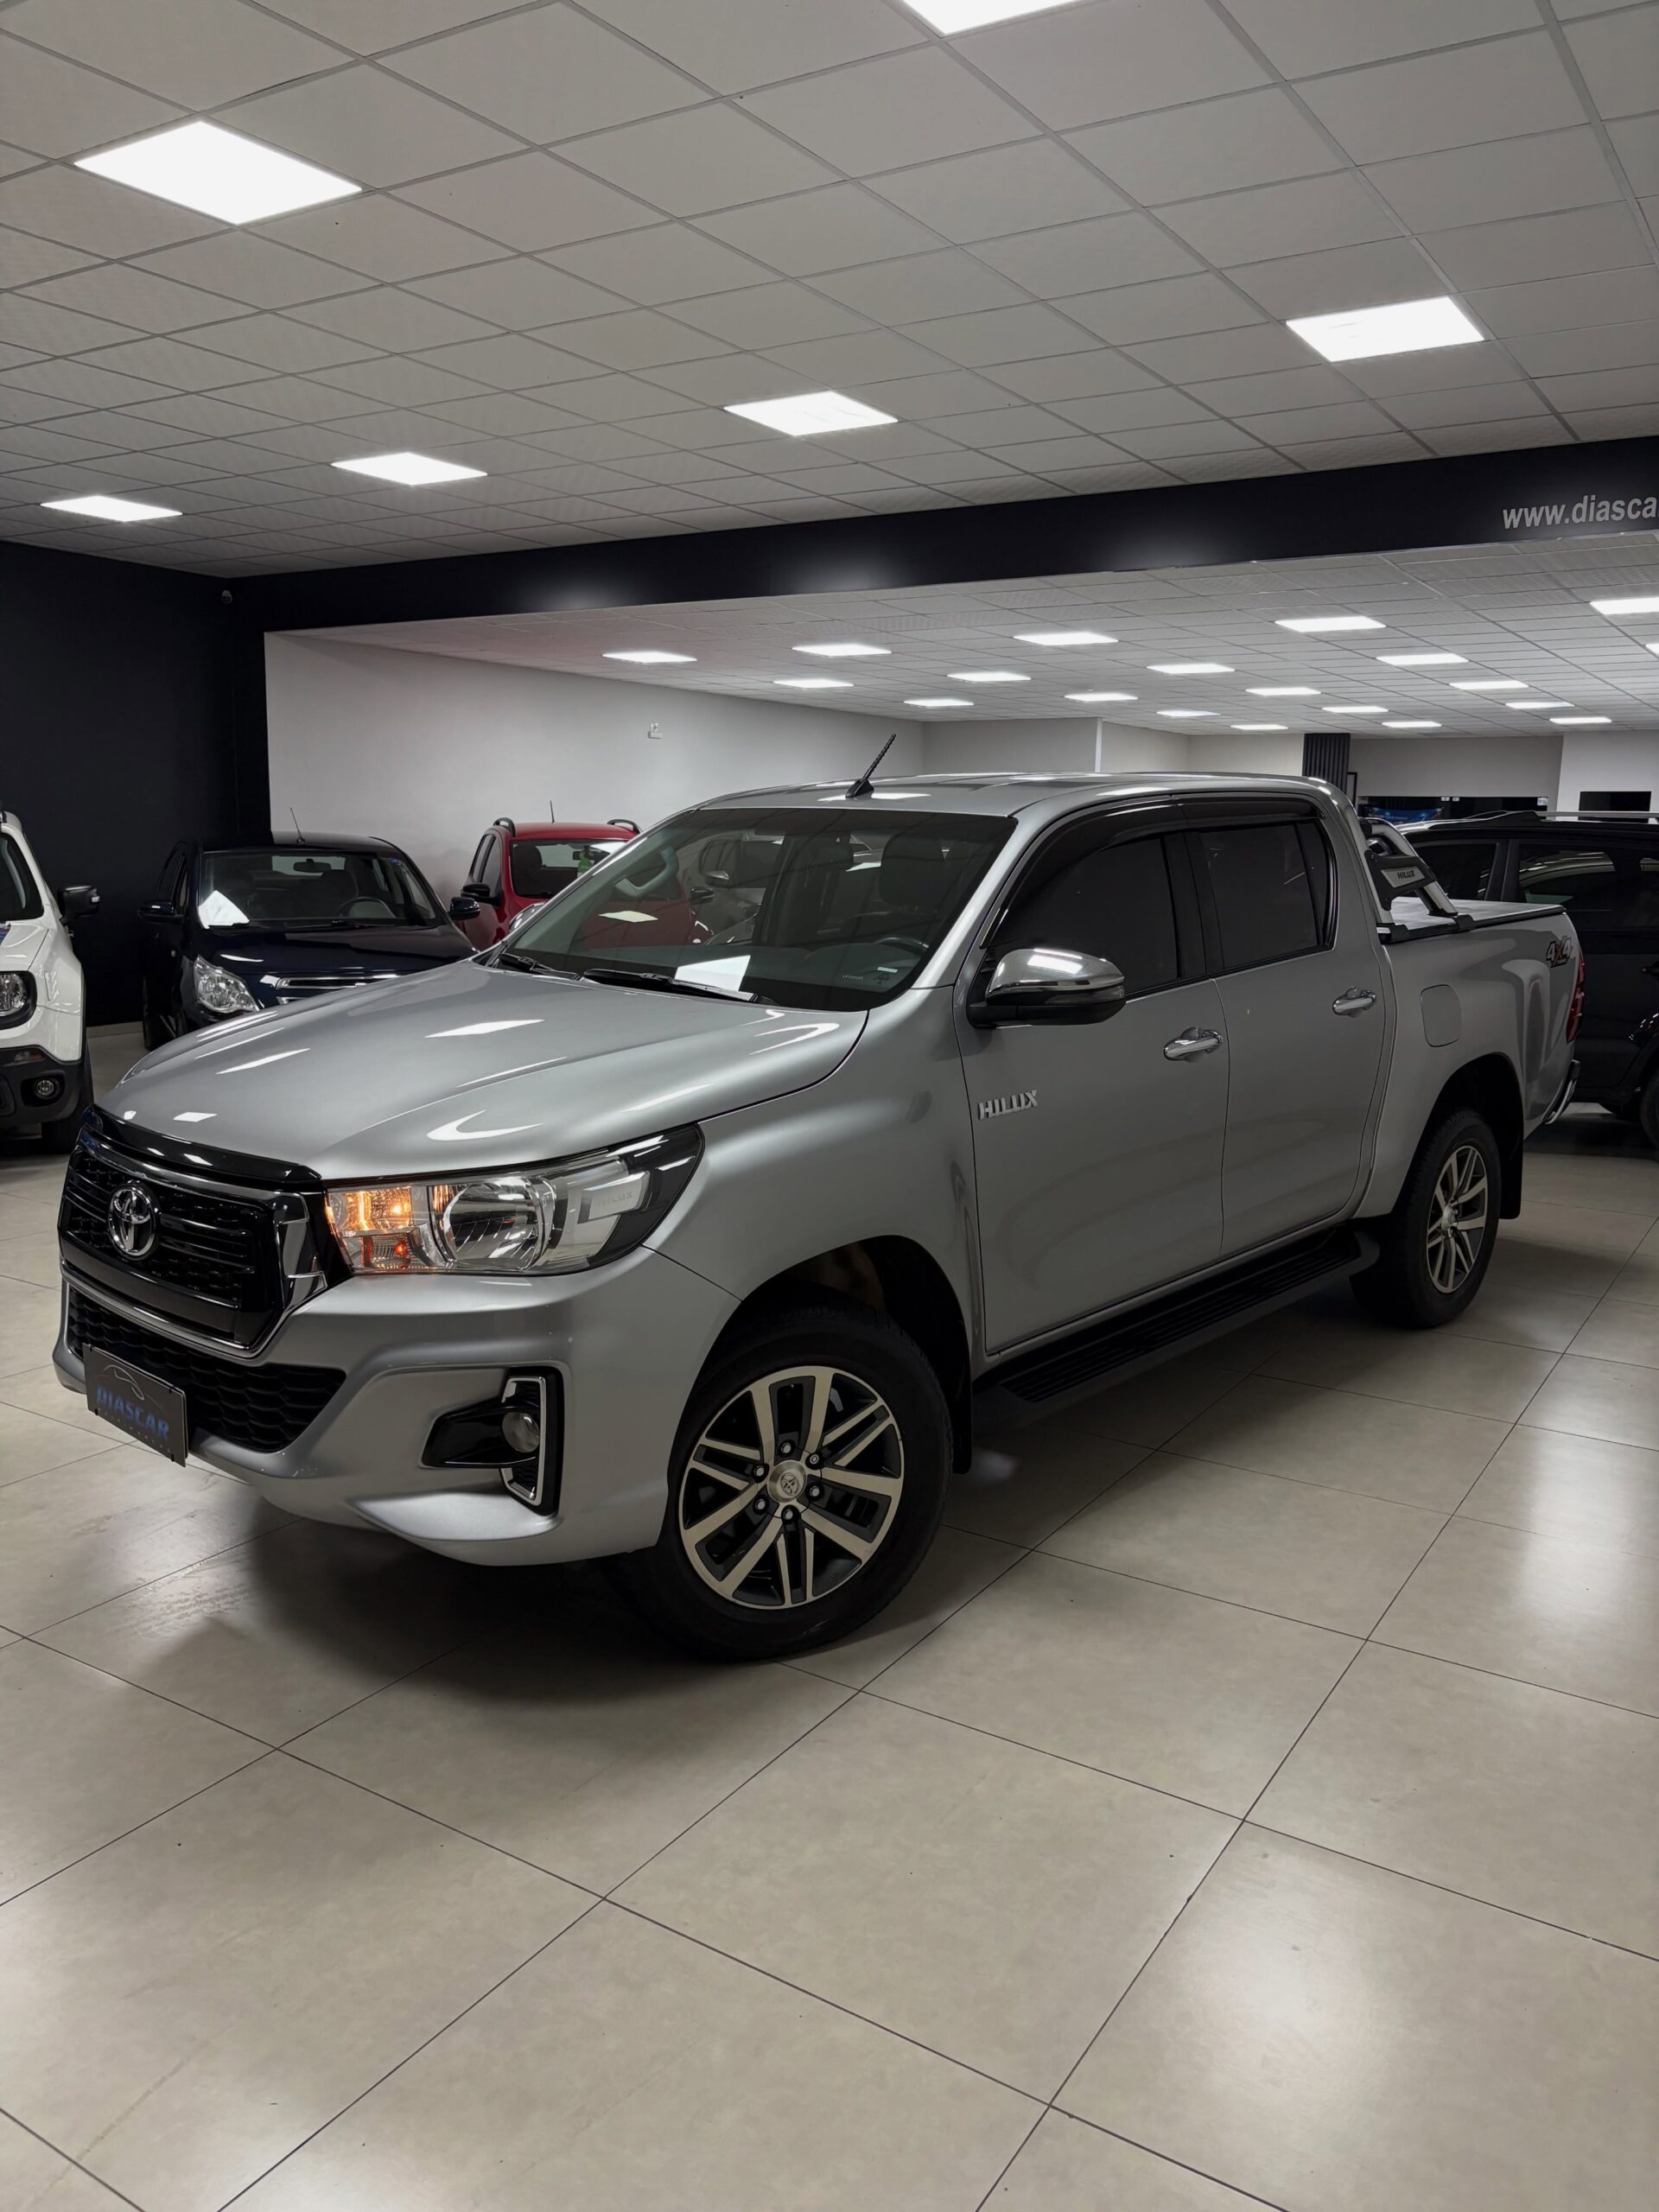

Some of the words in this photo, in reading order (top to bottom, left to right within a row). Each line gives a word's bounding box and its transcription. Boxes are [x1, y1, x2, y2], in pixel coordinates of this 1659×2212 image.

[1396, 870, 1415, 880] HILUX
[977, 1090, 1038, 1121] HILUX
[96, 1385, 169, 1440] DIASCAR
